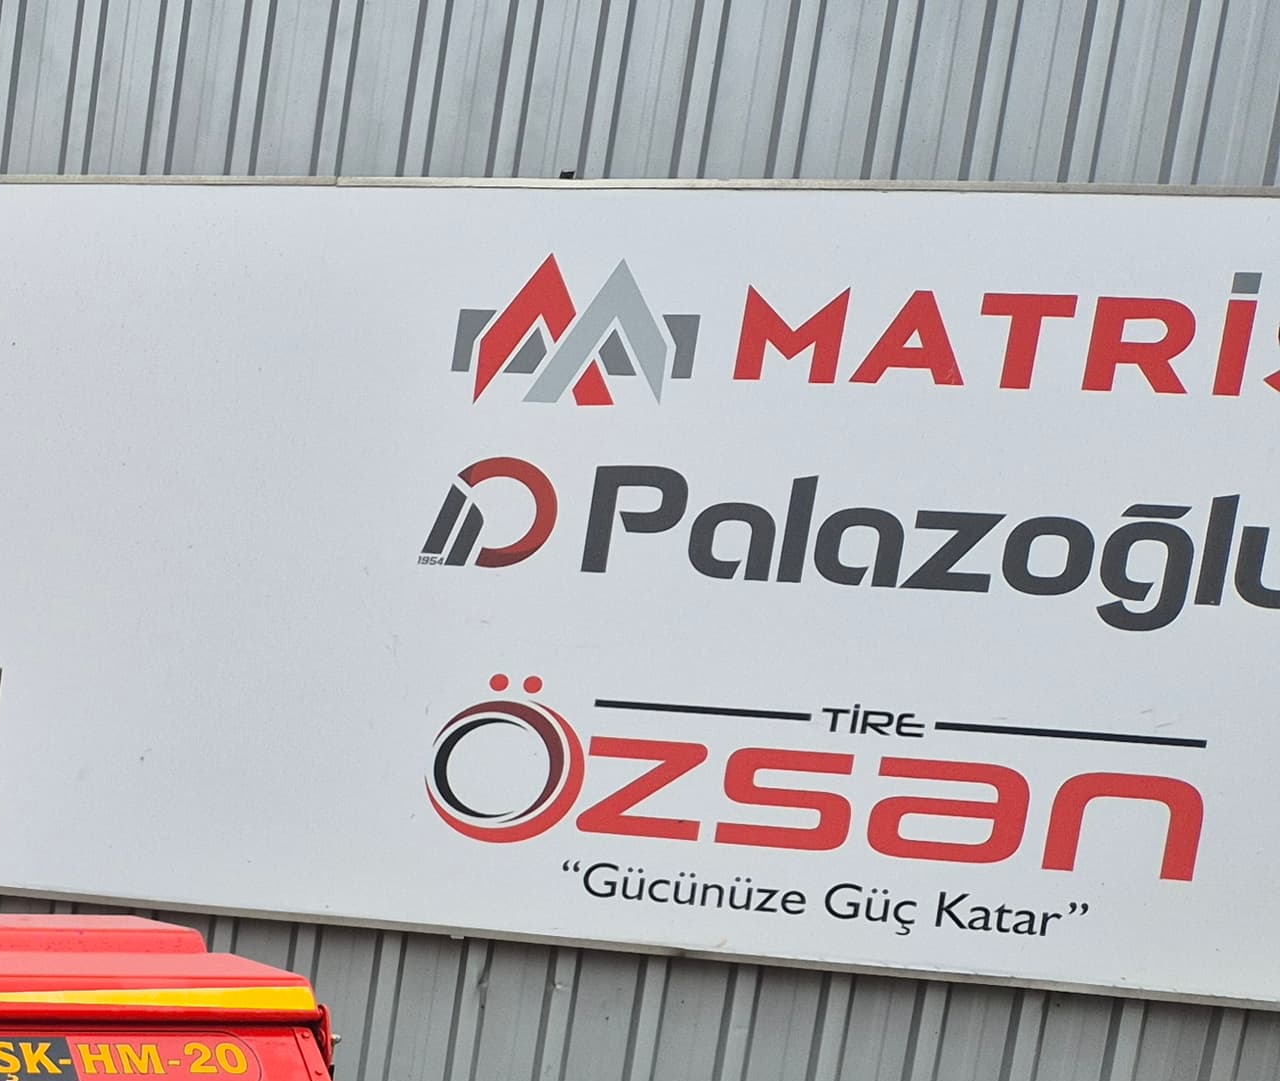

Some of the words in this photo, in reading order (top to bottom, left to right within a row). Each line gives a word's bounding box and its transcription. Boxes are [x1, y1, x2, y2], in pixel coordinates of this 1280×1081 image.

[732, 271, 1280, 397] MATRİ
[417, 555, 445, 566] 1954
[822, 703, 926, 738] TİRE
[424, 673, 1205, 882] Özsan
[823, 883, 918, 936] Güç
